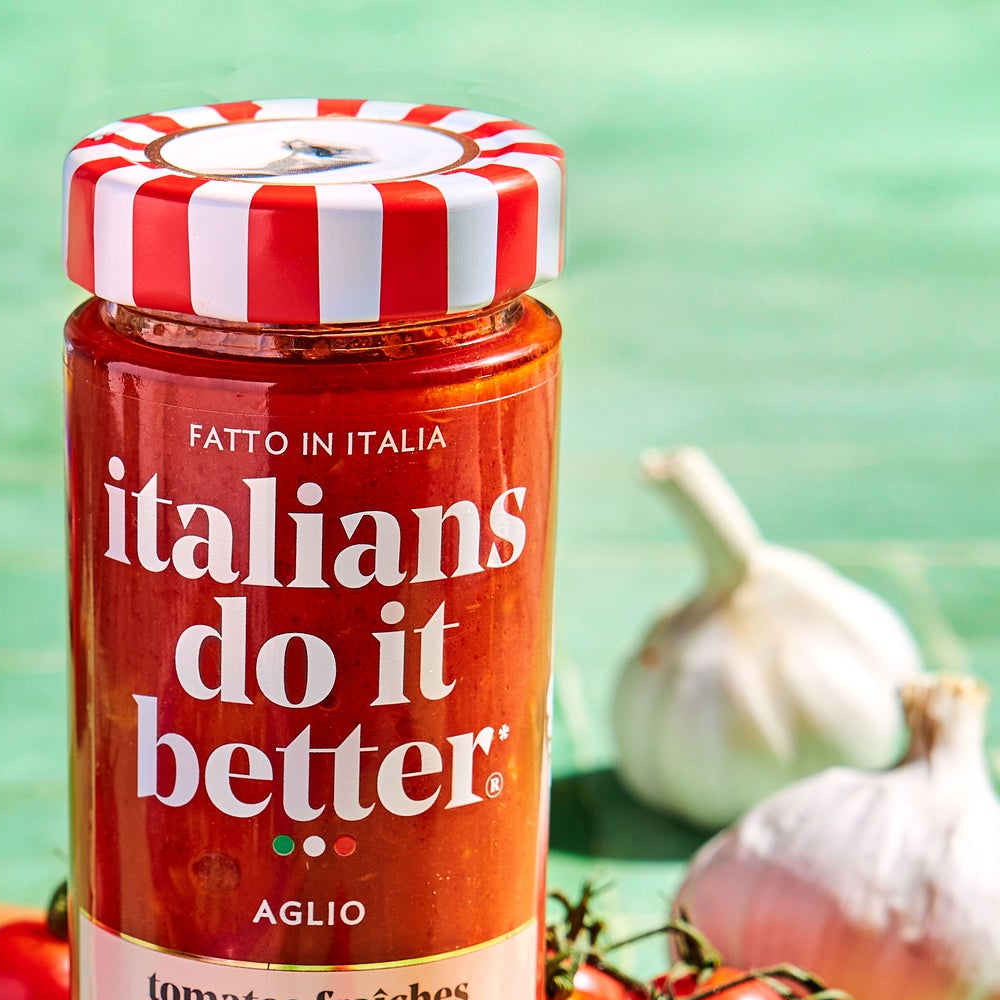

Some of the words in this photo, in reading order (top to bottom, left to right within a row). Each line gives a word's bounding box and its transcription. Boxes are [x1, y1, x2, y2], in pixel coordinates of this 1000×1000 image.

[190, 424, 288, 455] FATTO
[302, 432, 333, 456] IN
[347, 425, 447, 455] ITALIA
[103, 456, 527, 589] italians
[175, 596, 337, 708] do
[370, 601, 460, 706] it
[252, 899, 366, 926] AGLIO
